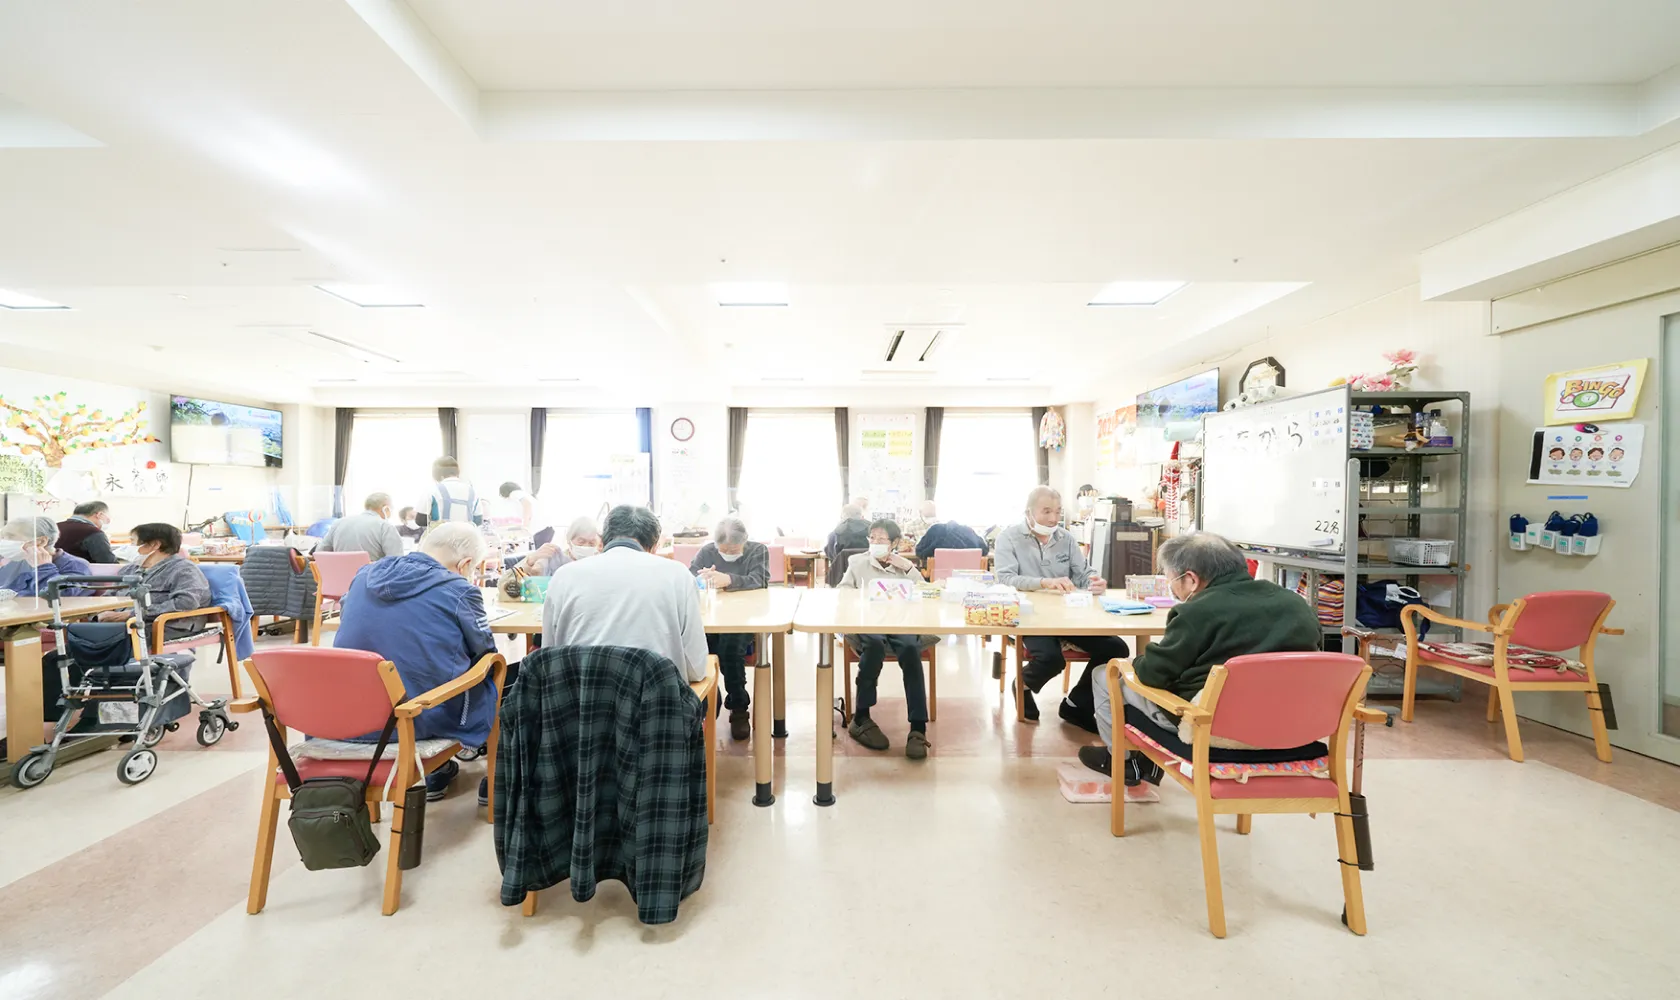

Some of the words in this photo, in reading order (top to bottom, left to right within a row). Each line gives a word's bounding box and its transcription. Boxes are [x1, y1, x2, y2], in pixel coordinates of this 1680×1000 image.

[1564, 379, 1625, 401] BINGO
[105, 473, 123, 491] 永
[1314, 519, 1340, 535] 22名
